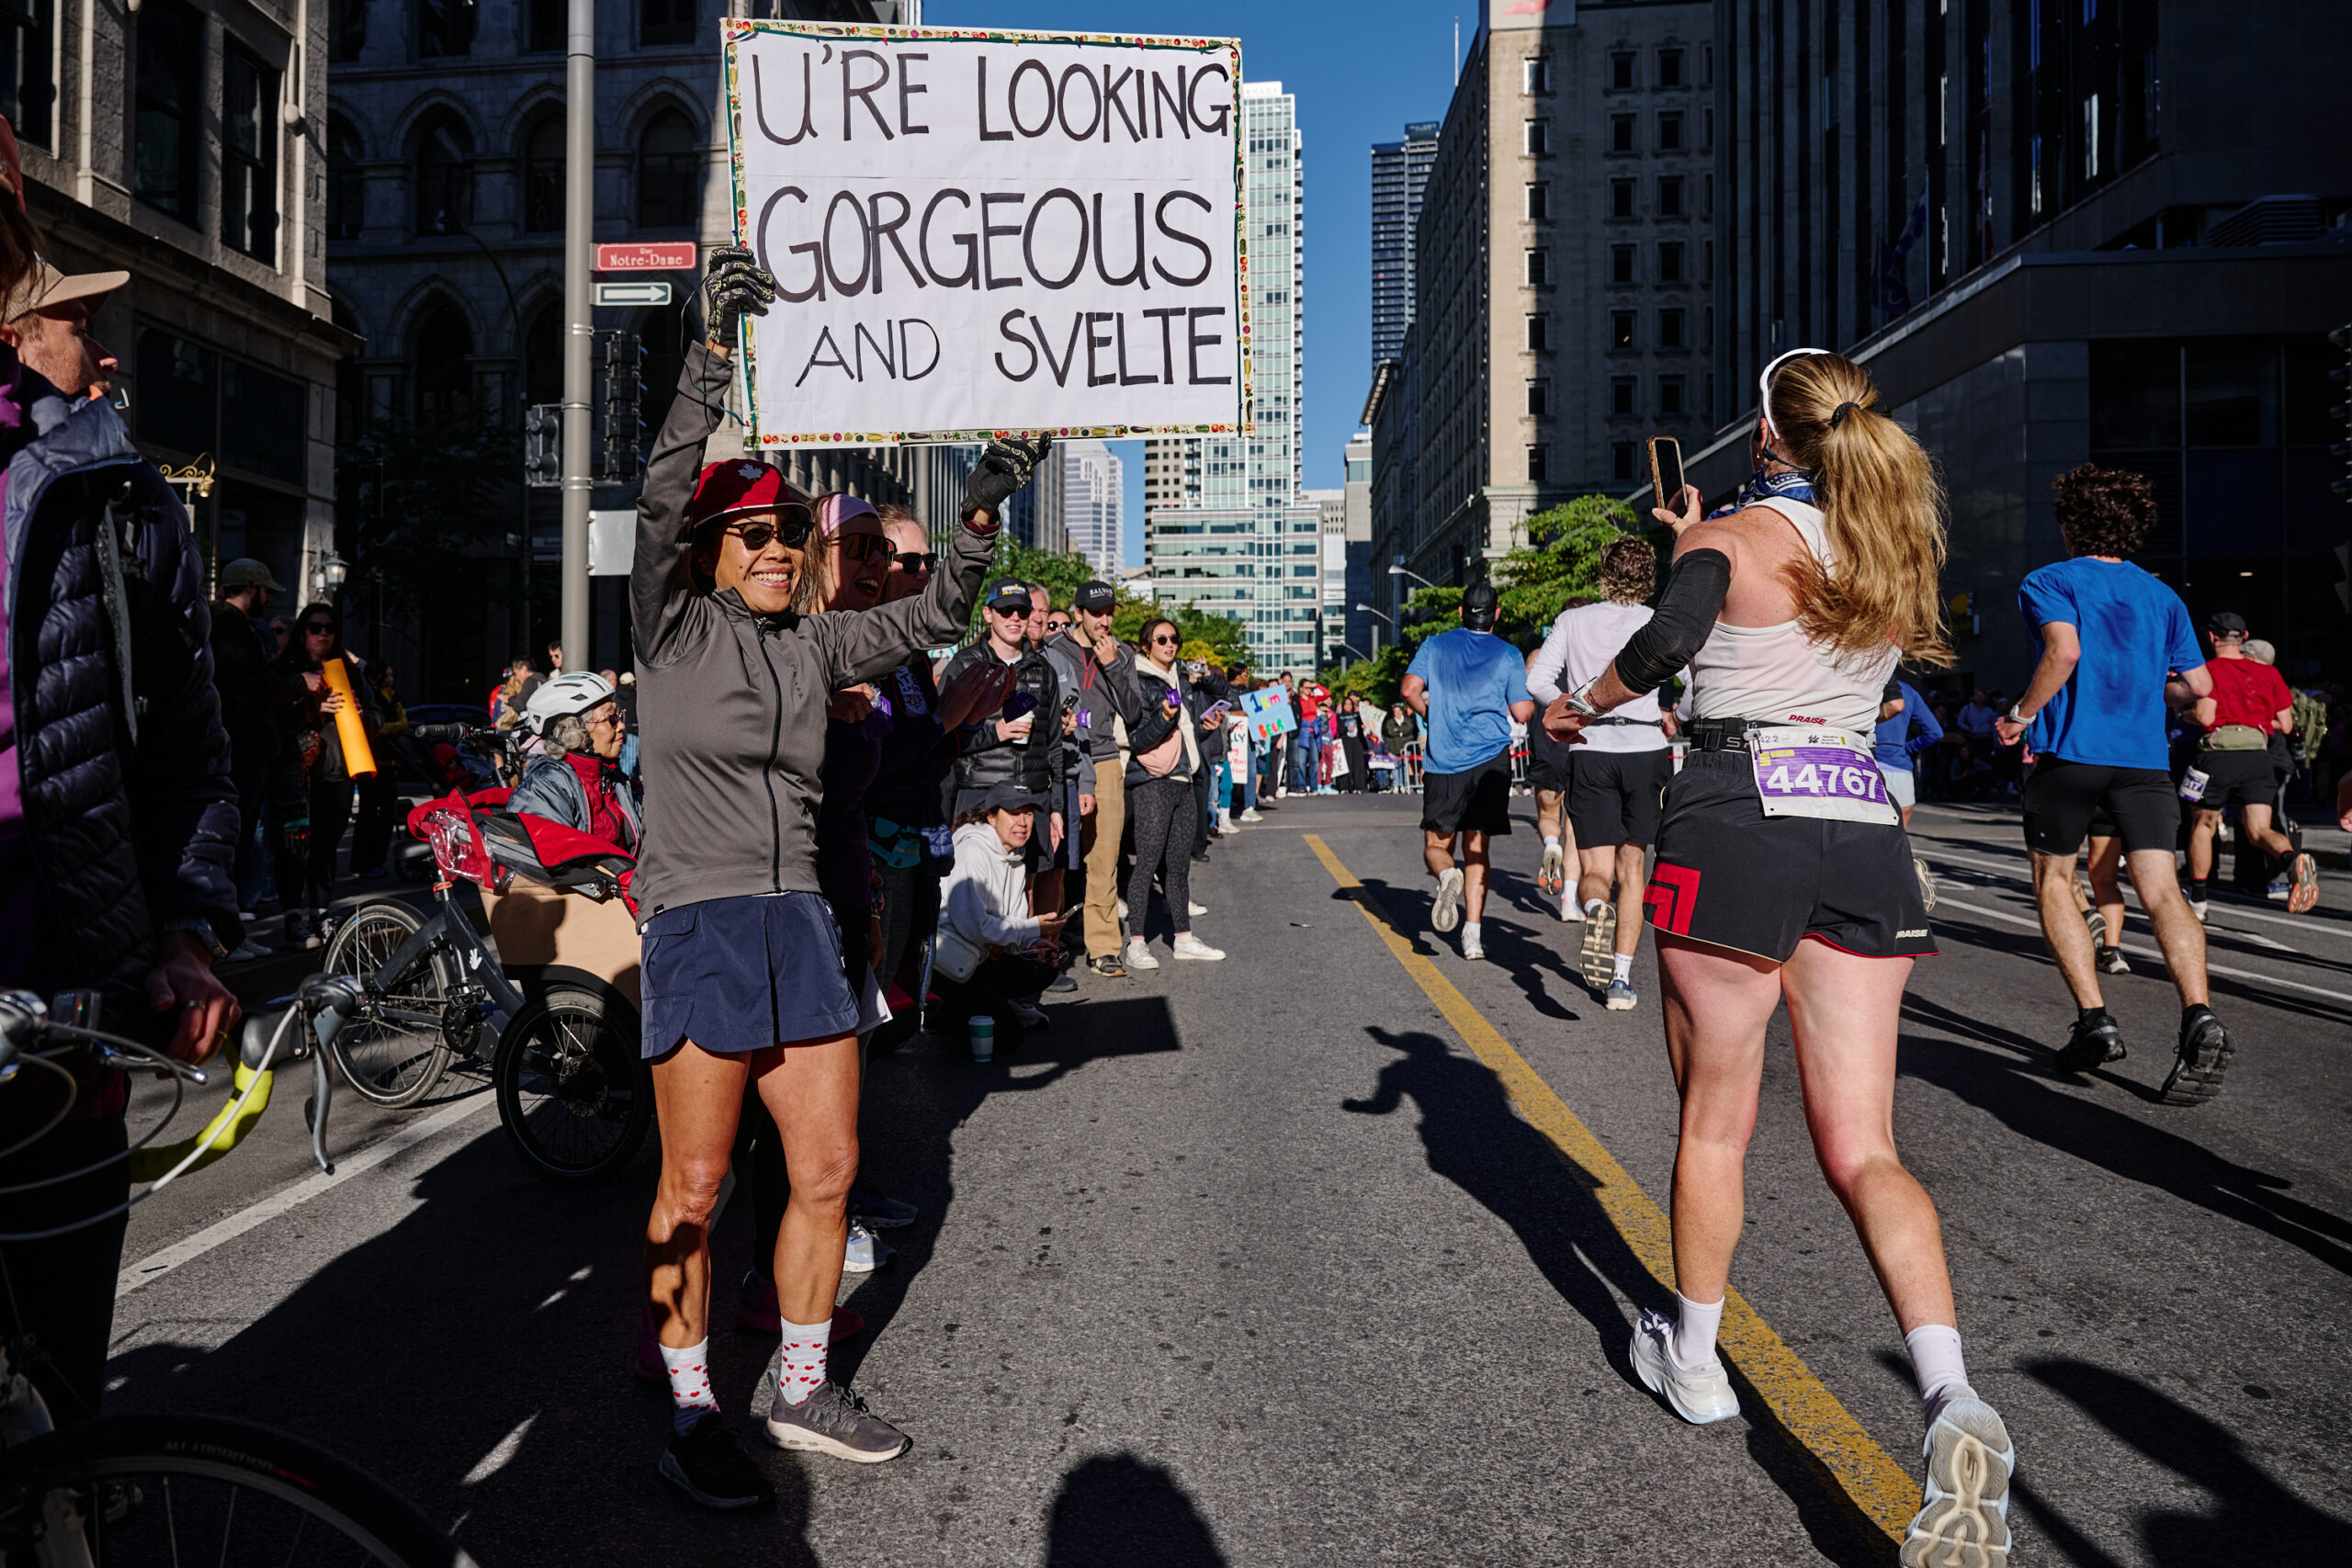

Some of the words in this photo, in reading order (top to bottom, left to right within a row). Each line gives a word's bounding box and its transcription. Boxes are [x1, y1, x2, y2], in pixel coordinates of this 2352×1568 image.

[753, 43, 929, 146] U'RE
[978, 56, 1231, 143] LOOKING
[610, 254, 683, 266] Notre-Dame
[756, 186, 1212, 303] GORGEOUS
[795, 318, 940, 388] AND
[994, 307, 1232, 388] SVELTE
[1258, 718, 1285, 739] BEER
[1789, 715, 1827, 726] PRAISE
[1767, 763, 1879, 798] 44767
